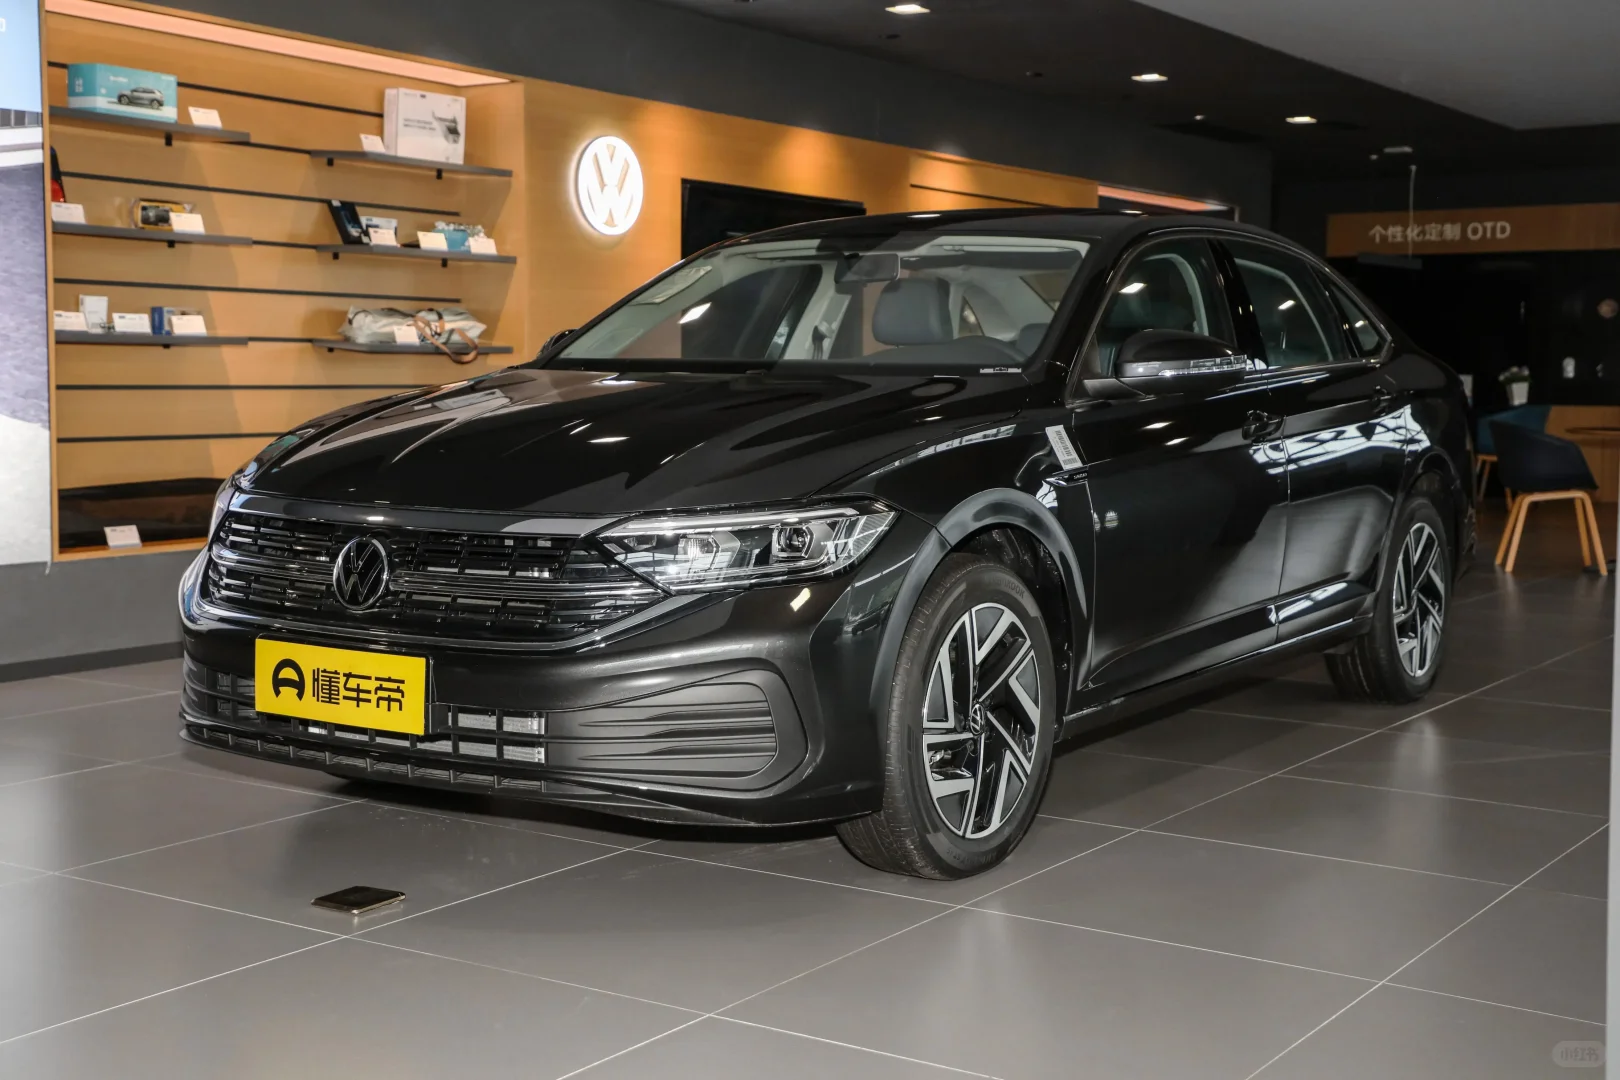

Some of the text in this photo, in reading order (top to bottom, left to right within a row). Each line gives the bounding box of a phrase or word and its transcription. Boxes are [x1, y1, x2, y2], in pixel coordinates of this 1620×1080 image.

[1368, 220, 1511, 244] 个性化定制 OTD
[312, 667, 406, 712] 懂车帝
